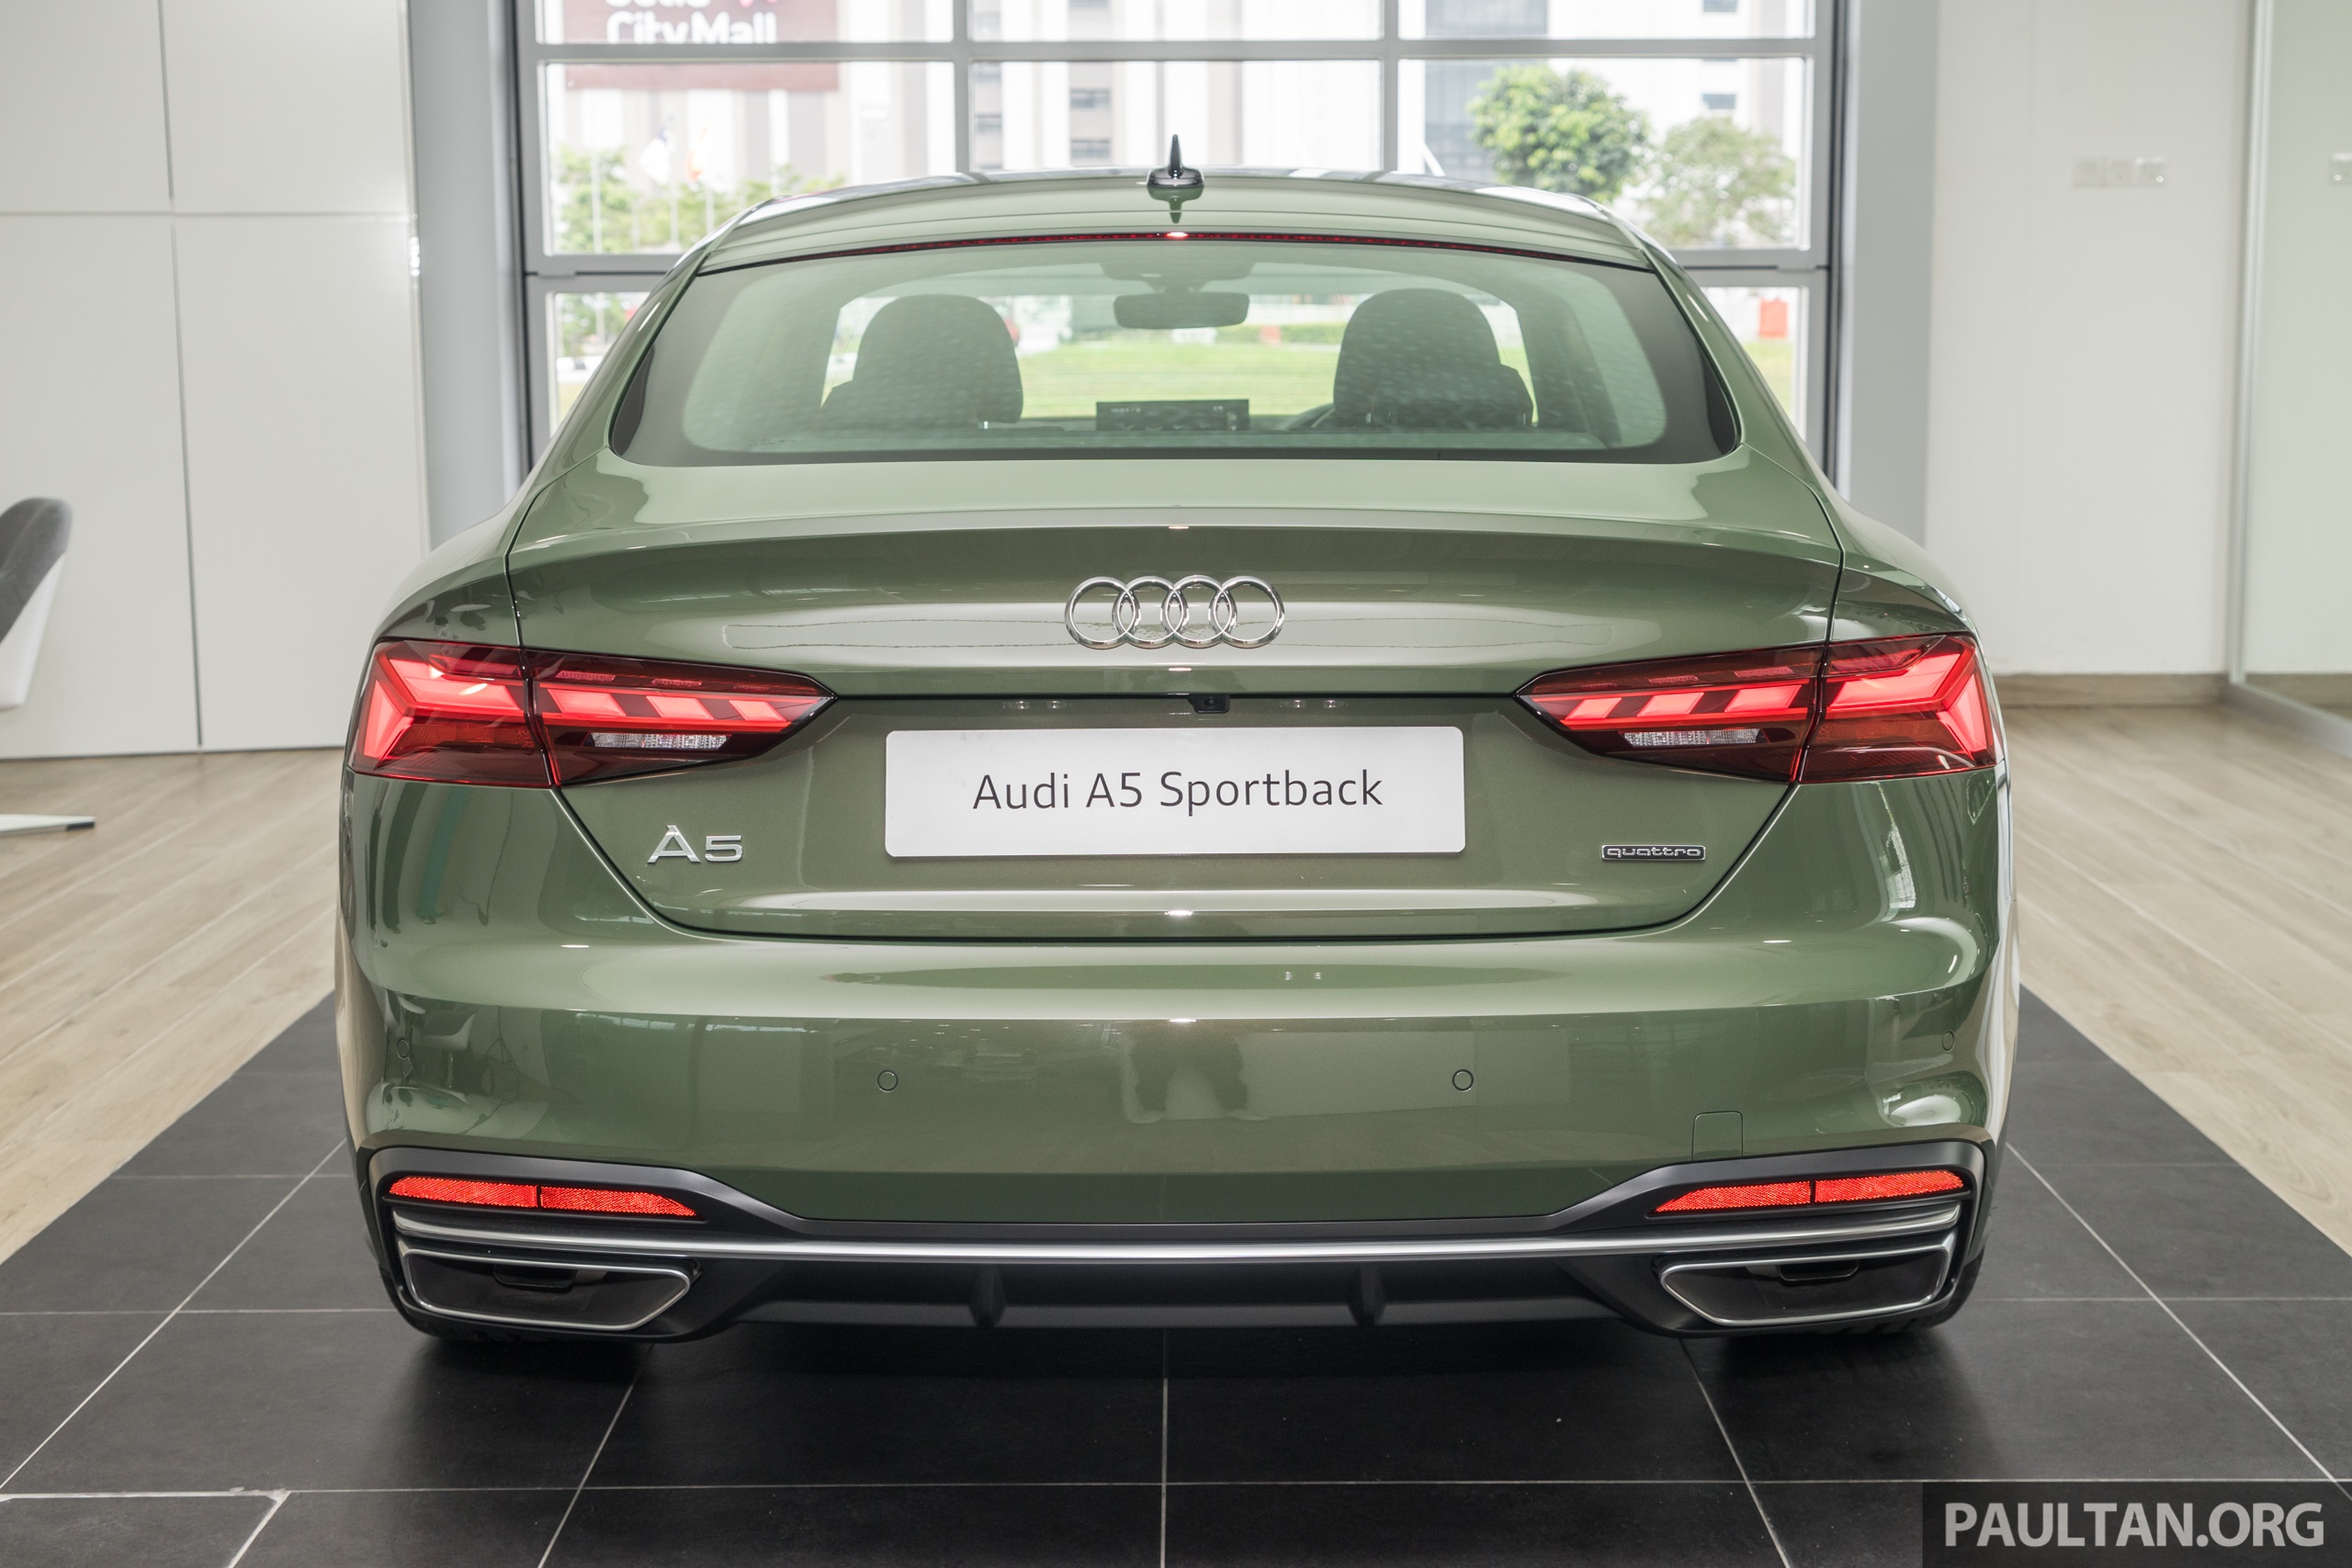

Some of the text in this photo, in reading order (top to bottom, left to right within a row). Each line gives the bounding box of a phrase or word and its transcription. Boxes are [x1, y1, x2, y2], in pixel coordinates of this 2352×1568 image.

[972, 769, 1384, 817] Audi A5 Sportback
[647, 825, 743, 863] A5
[1606, 846, 1702, 858] quattro
